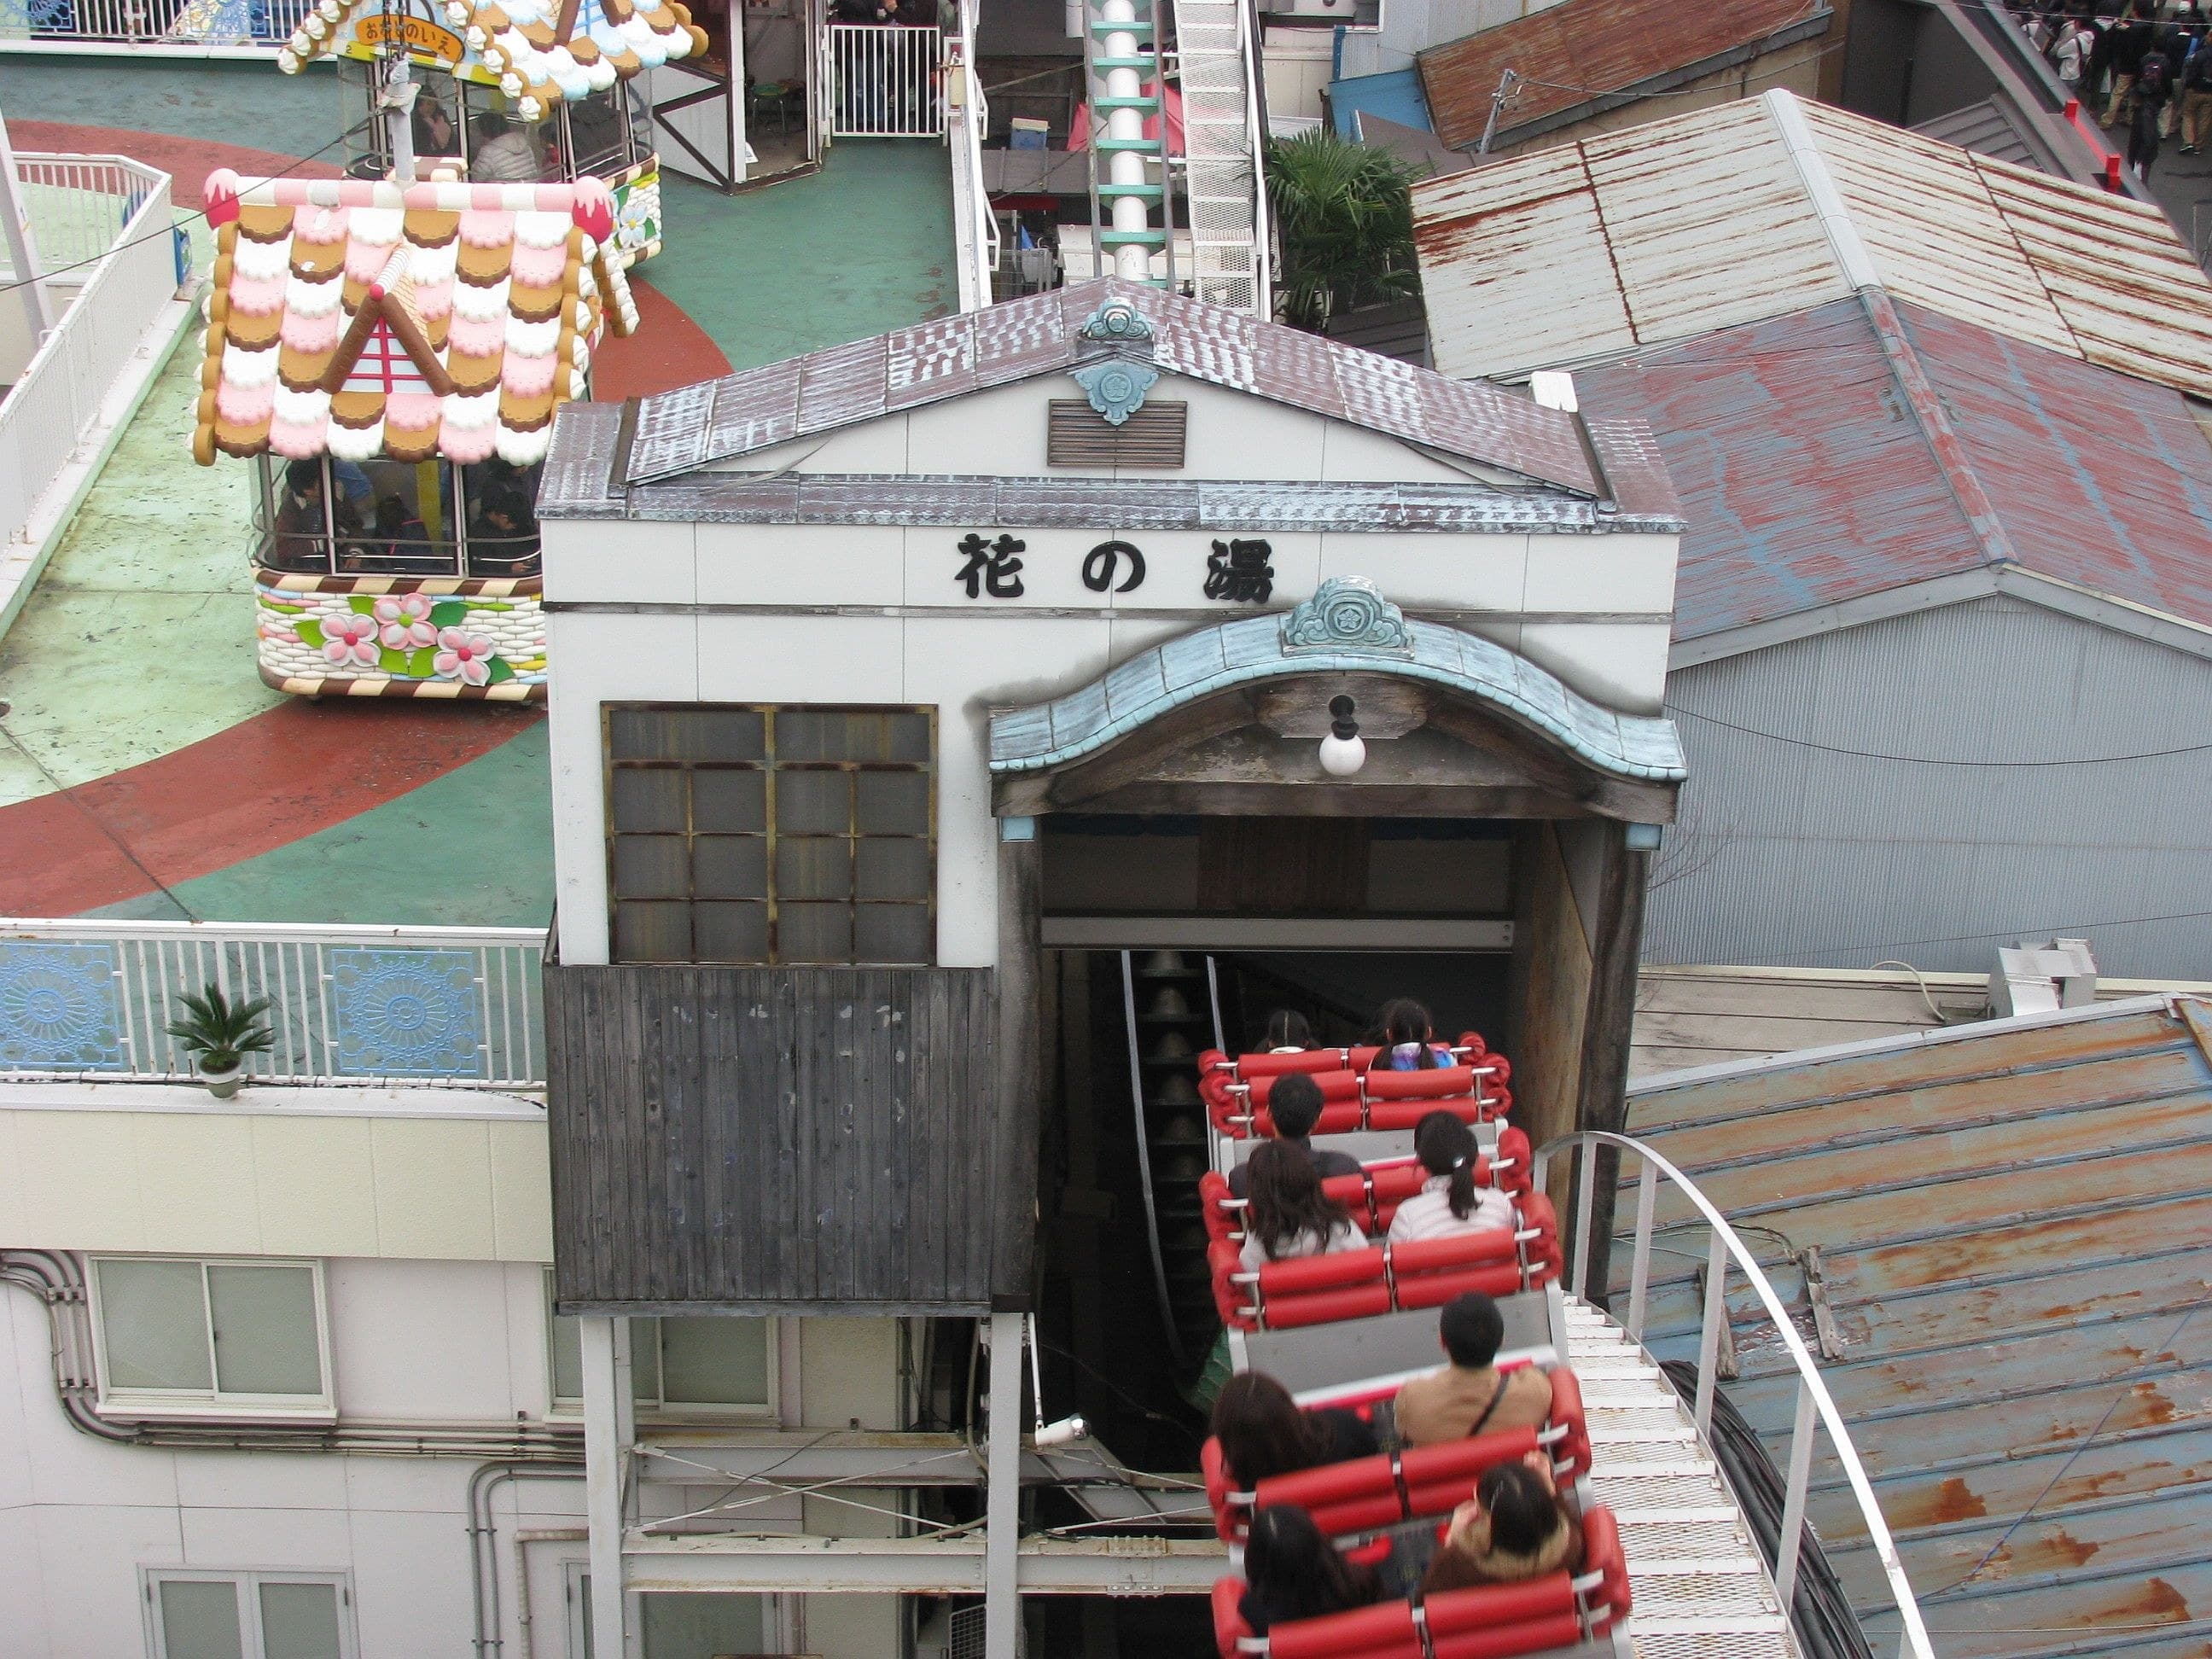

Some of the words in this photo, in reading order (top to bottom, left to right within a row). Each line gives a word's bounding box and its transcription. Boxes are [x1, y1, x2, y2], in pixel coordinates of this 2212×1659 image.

[346, 44, 352, 54] 2
[367, 20, 449, 55] おのいえ
[954, 533, 1275, 603] 花の湯
